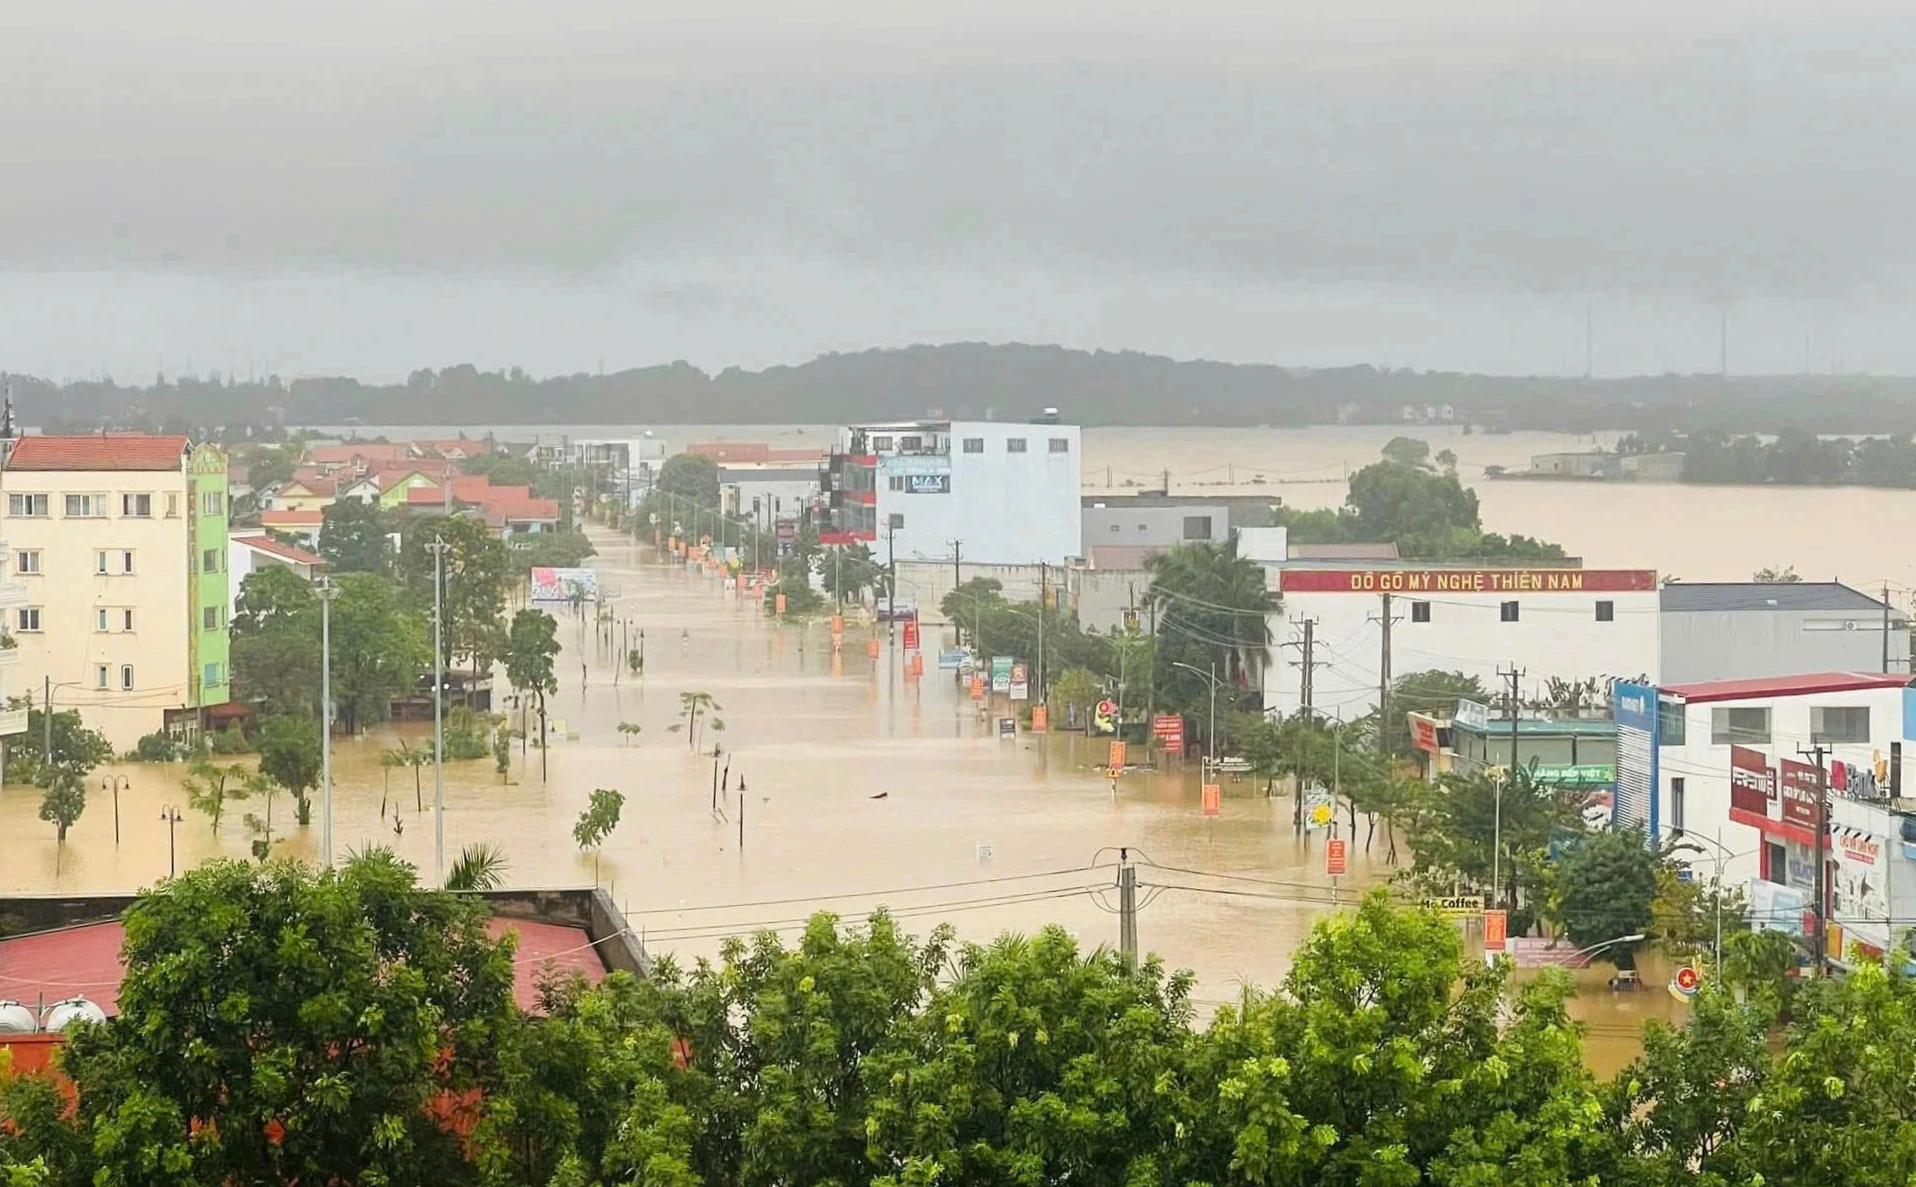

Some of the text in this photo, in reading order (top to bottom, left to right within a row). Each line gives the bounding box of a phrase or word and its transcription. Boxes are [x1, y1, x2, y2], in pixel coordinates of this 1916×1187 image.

[1437, 571, 1484, 591] NGHỆ
[1548, 574, 1583, 589] NAM
[1441, 897, 1479, 908] Coffee
